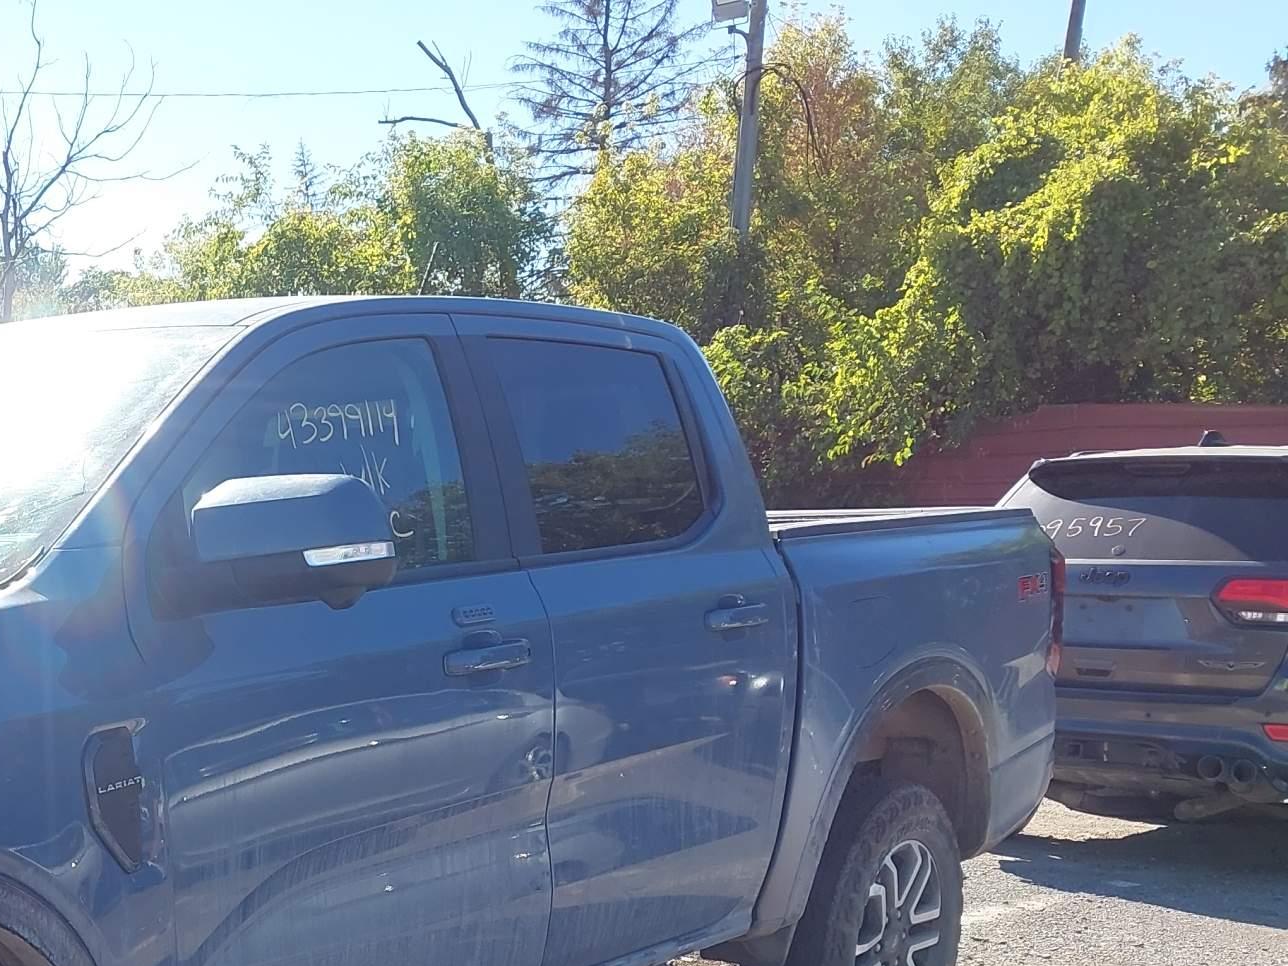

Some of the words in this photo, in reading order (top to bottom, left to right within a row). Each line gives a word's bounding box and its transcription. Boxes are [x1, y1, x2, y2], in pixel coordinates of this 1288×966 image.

[276, 398, 401, 449] 43399114
[1039, 515, 1148, 541] 95957
[97, 775, 142, 795] LARIAT
